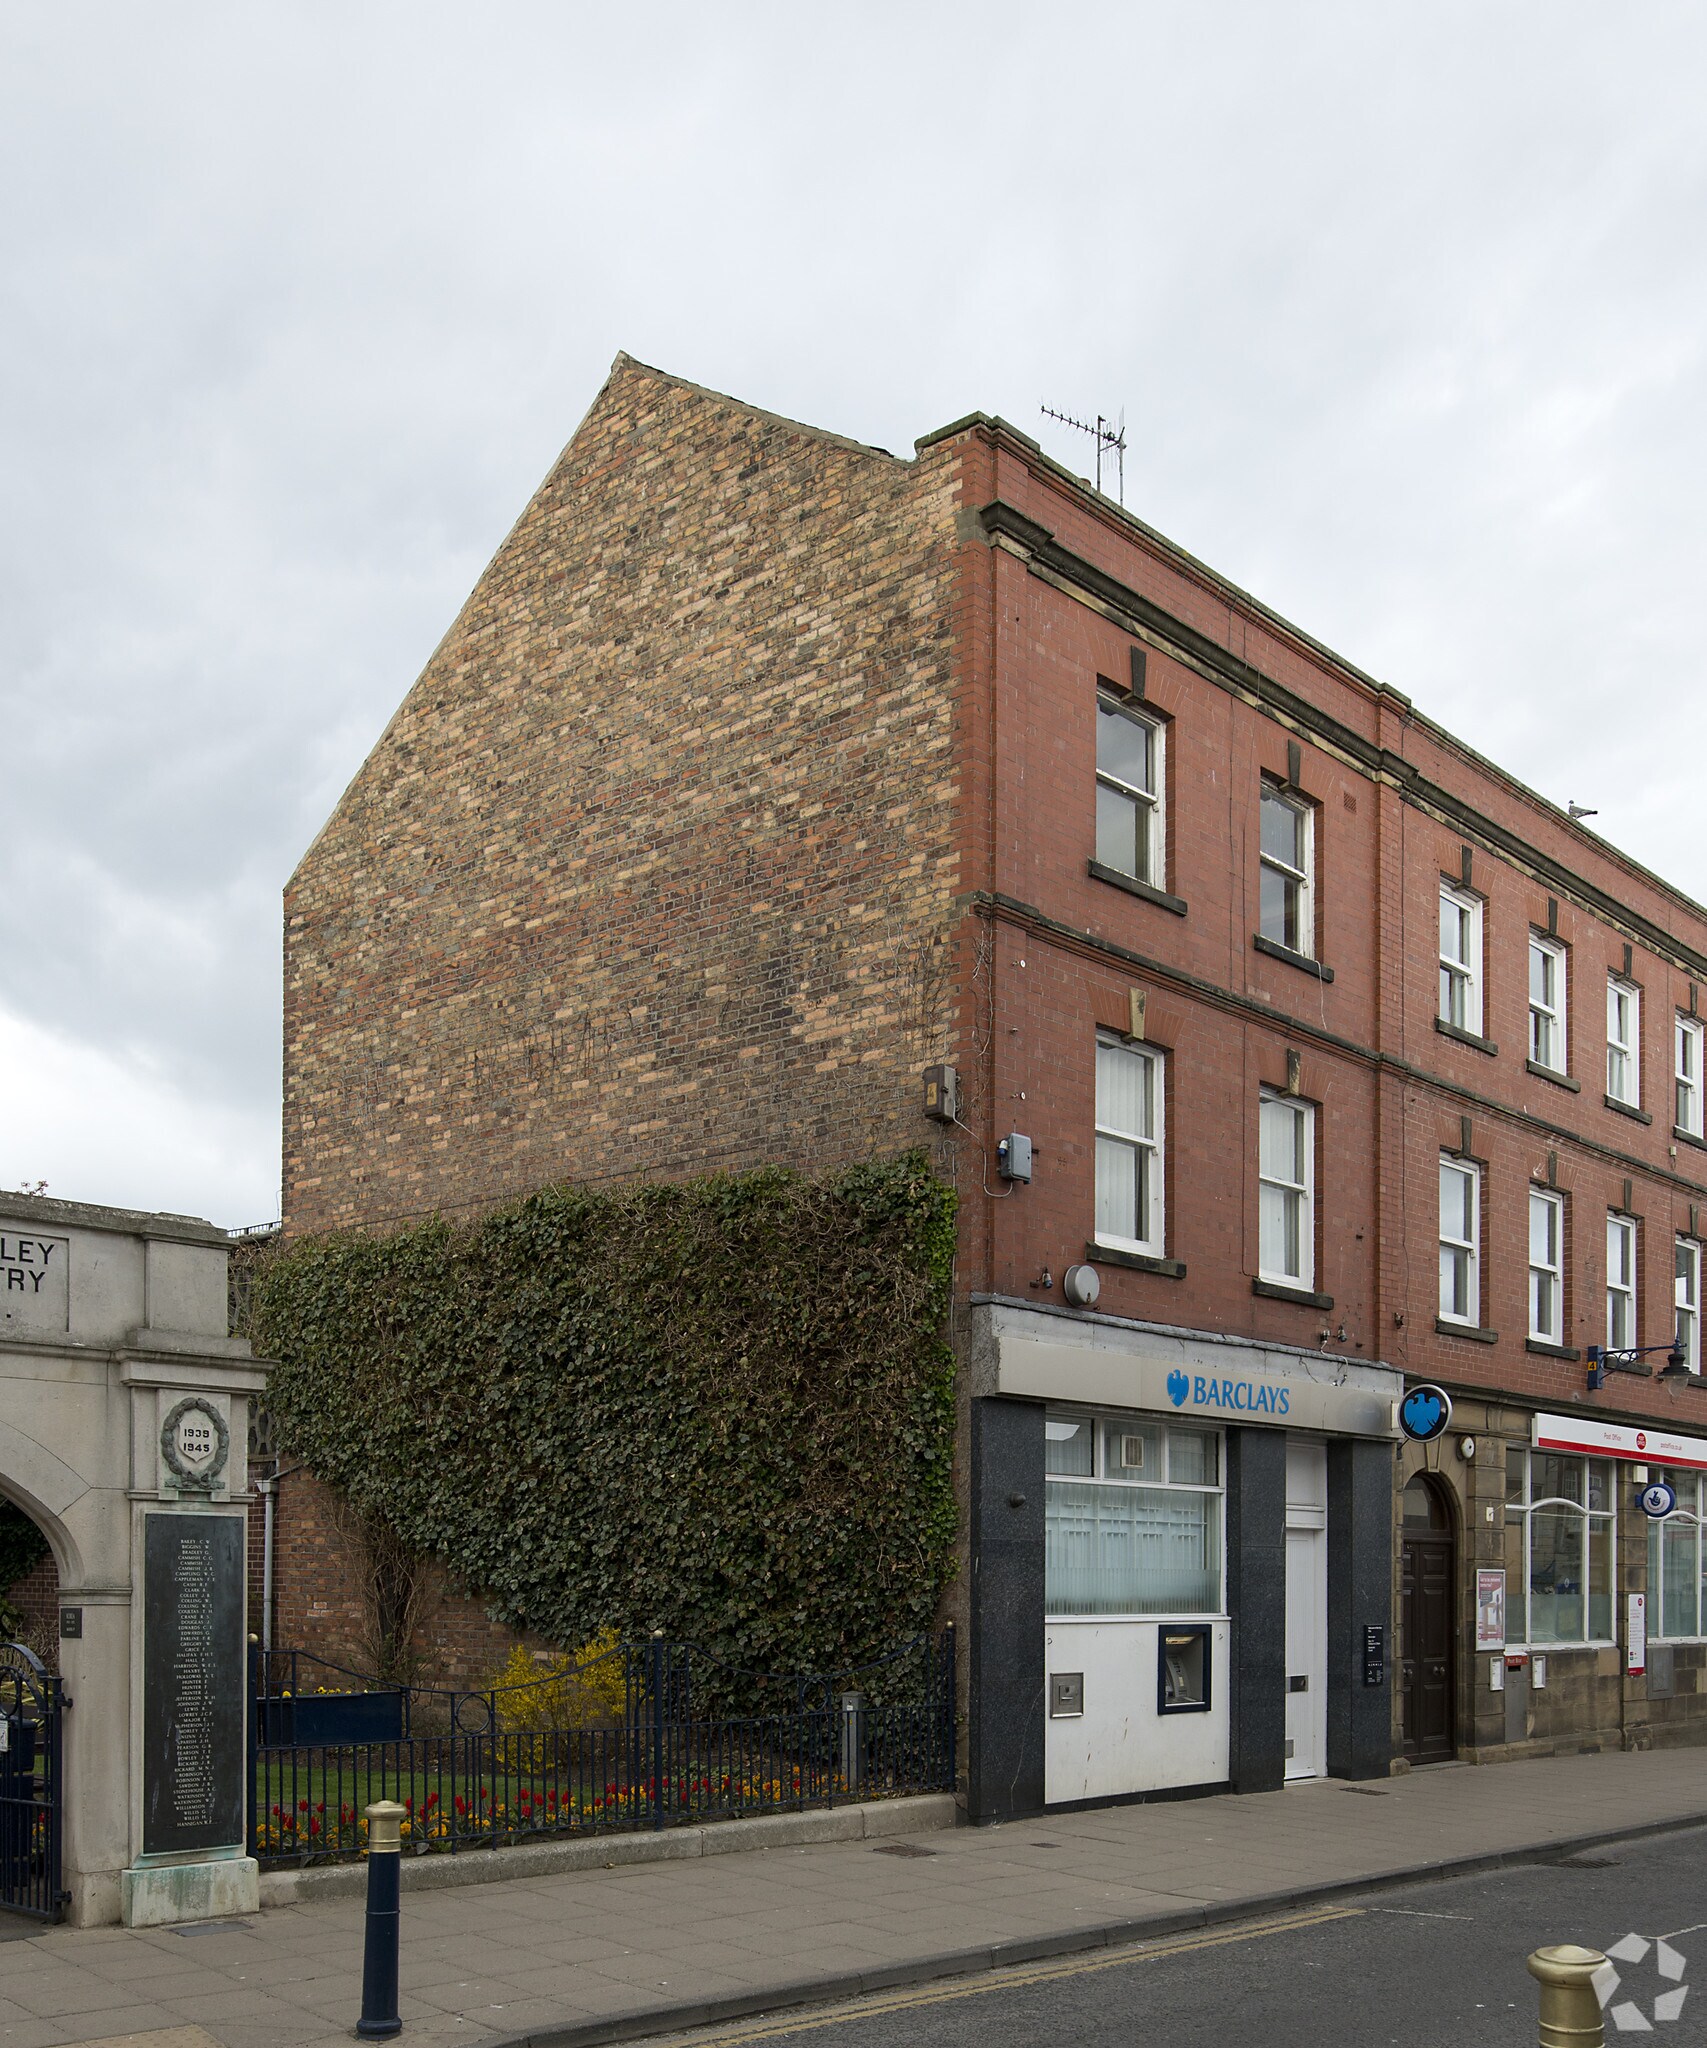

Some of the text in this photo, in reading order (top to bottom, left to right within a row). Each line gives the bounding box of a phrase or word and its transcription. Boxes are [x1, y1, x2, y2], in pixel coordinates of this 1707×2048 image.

[1193, 1376, 1290, 1415] BARCLAYS
[184, 1428, 210, 1438] 1939
[1612, 1433, 1622, 1441] Office
[184, 1442, 210, 1452] 1945
